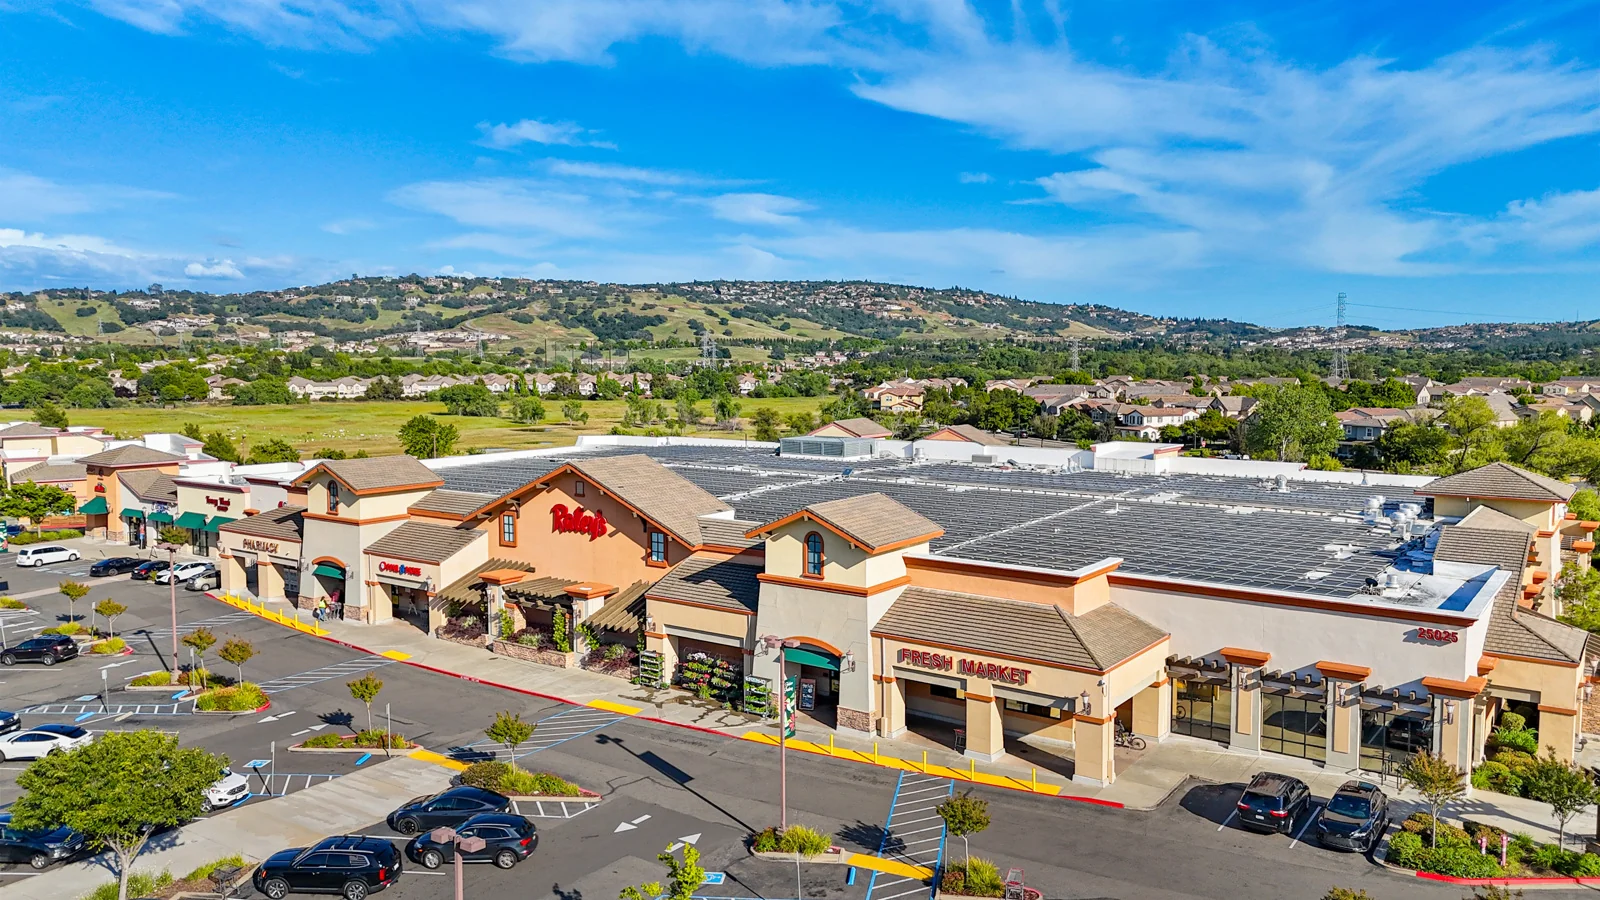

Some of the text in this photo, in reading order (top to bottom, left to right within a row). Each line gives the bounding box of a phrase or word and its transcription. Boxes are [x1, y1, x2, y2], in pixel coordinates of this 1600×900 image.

[549, 503, 608, 542] Raley's
[242, 538, 279, 554] PHARMACY
[1417, 627, 1459, 643] 25025
[899, 648, 1032, 685] FRESH MARKET
